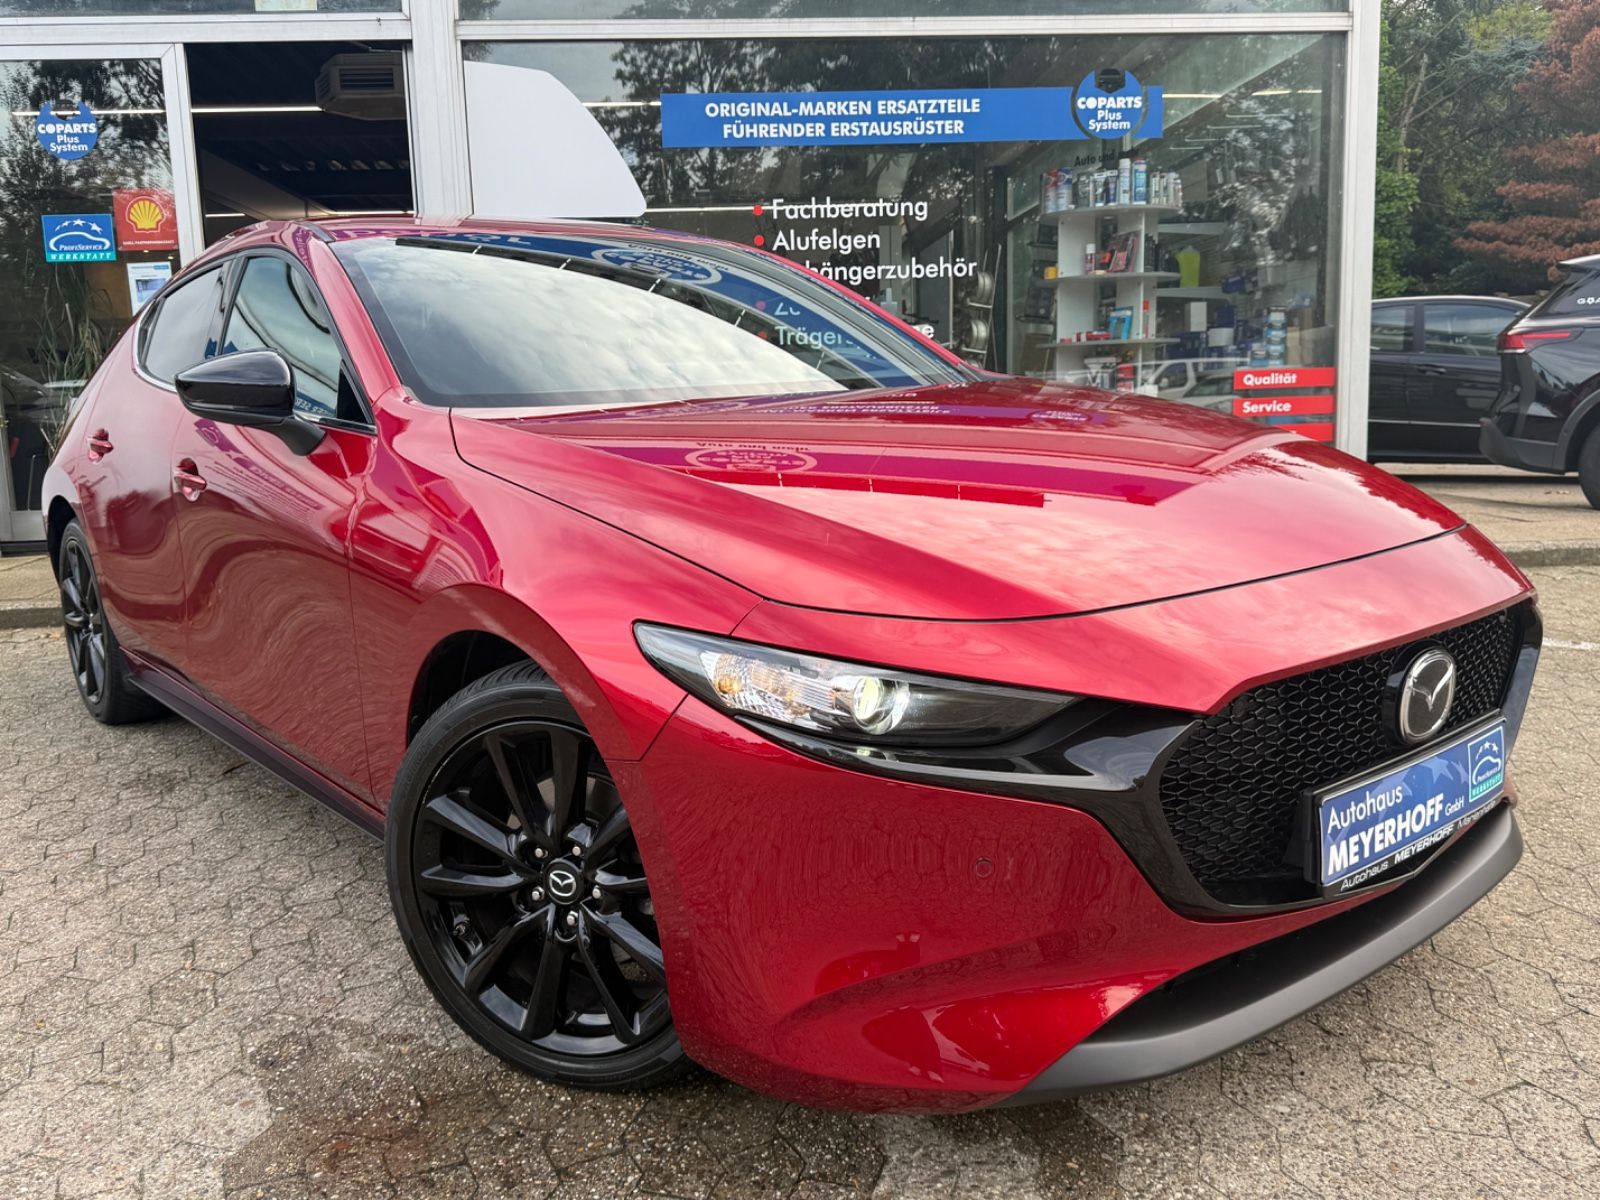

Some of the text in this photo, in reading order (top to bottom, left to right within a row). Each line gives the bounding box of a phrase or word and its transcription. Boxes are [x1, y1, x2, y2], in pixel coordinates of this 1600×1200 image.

[705, 98, 981, 118] ORIGINAL-MARKEN ERSATZTEILE
[1077, 96, 1143, 109] COPARTS
[1097, 110, 1122, 120] Plus
[37, 123, 97, 134] COPARTS
[723, 117, 964, 139] FÜHRENDER ERSTAUSRÜSTER
[1089, 119, 1131, 132] System
[56, 134, 80, 143] Plus
[50, 142, 88, 154] System
[772, 197, 928, 221] Fachberatung
[772, 228, 881, 254] Alufelgen
[50, 252, 112, 260] WERKSTATT
[805, 256, 978, 285] hängerzubehör
[1243, 372, 1298, 386] Qualität
[1242, 400, 1292, 413] Service
[1328, 786, 1403, 834] Autohaus
[1328, 793, 1465, 876] MEYERHOFF GmbH
[1340, 861, 1389, 892] Autohaus
[1394, 825, 1455, 864] MEYERHOFF
